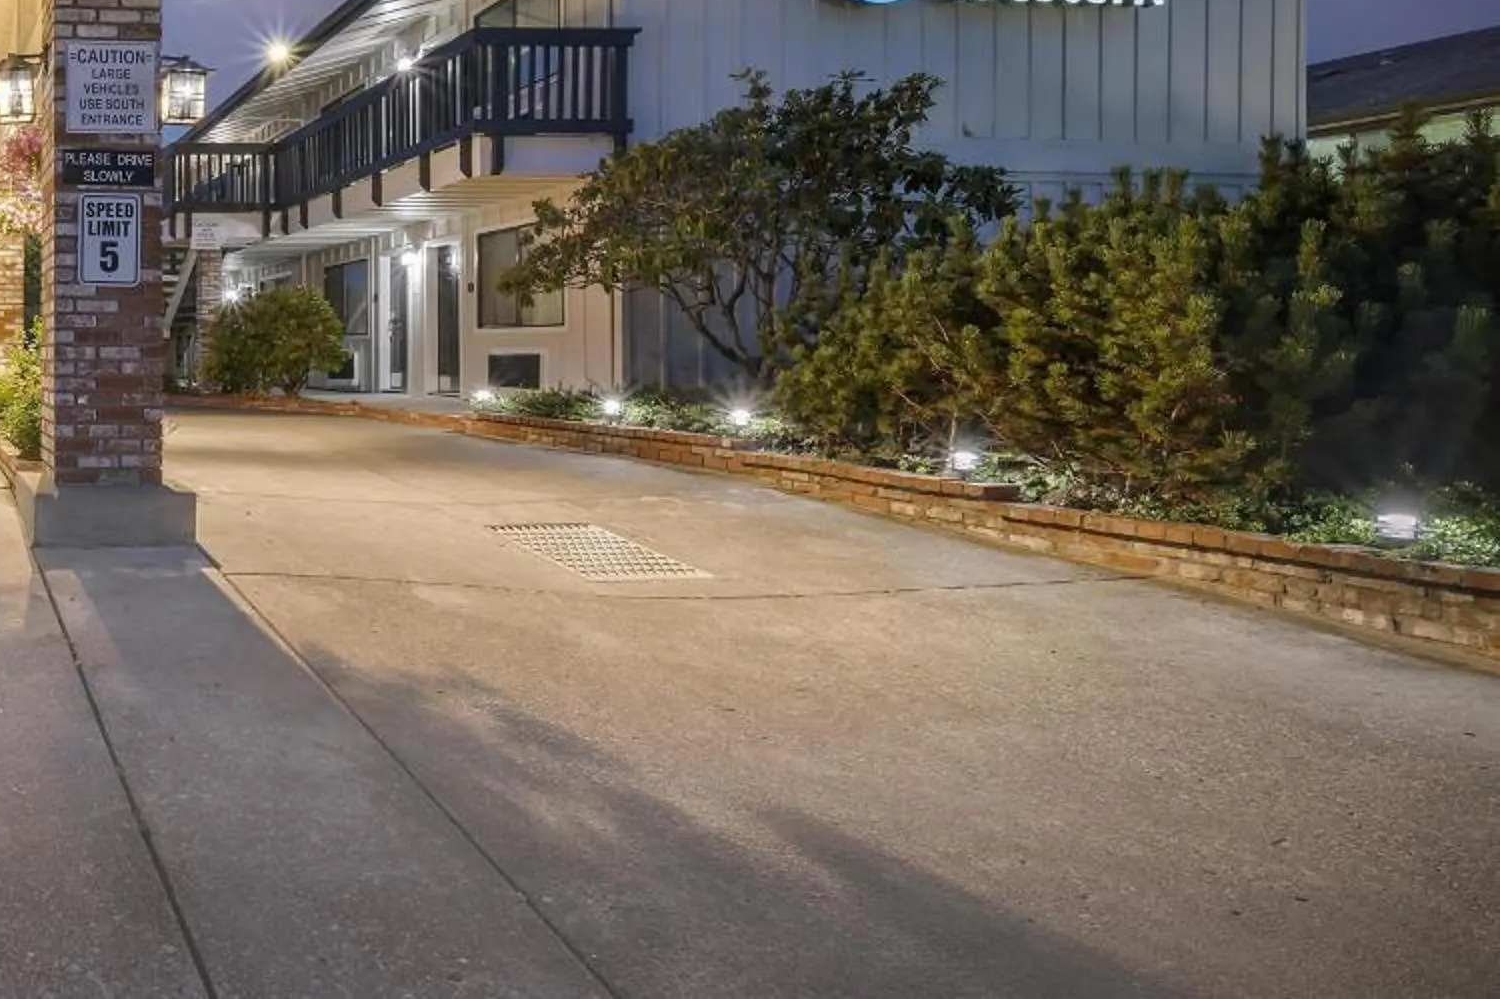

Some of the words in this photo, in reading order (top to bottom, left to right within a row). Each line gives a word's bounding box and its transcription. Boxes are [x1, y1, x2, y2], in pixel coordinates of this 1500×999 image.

[92, 68, 131, 80] LARGE
[84, 83, 140, 96] VEHICLES
[79, 98, 101, 110] USE
[105, 98, 145, 110] SOUTH
[81, 114, 144, 126] ENTRANCE
[65, 153, 111, 166] PLEASE
[117, 154, 153, 166] DRIVE
[83, 170, 134, 183] SLOWLY
[86, 202, 134, 218] SPEED
[88, 220, 131, 237] LIMIT
[99, 240, 119, 273] 5
